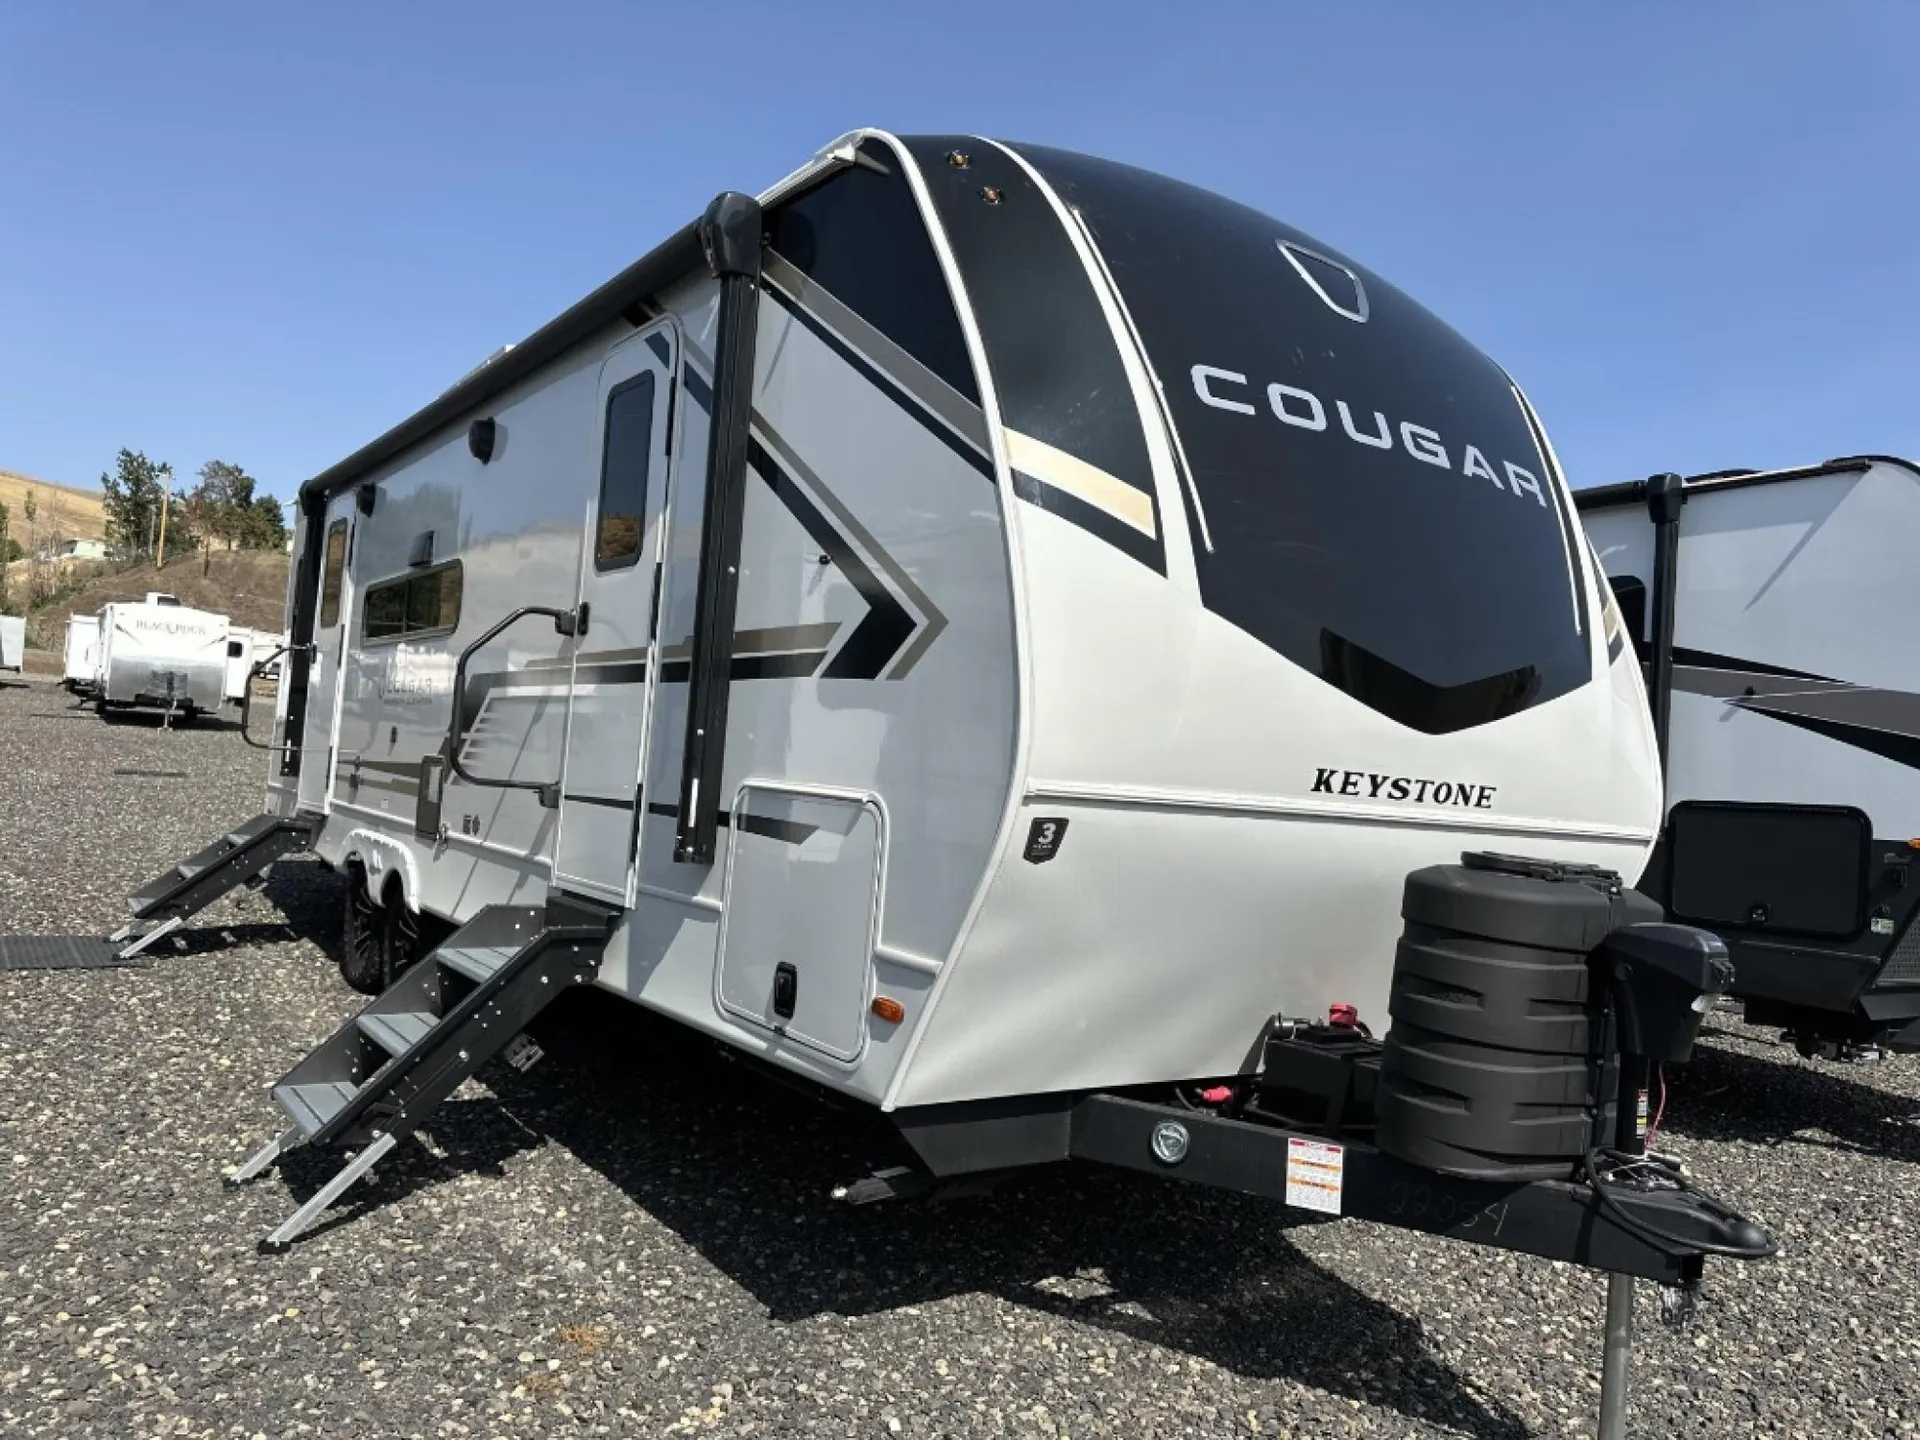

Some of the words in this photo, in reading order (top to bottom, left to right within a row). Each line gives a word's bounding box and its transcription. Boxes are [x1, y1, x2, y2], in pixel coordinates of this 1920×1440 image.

[1190, 363, 1547, 507] COUGAR
[1310, 767, 1497, 809] KEYSTONE
[1038, 822, 1056, 843] 3
